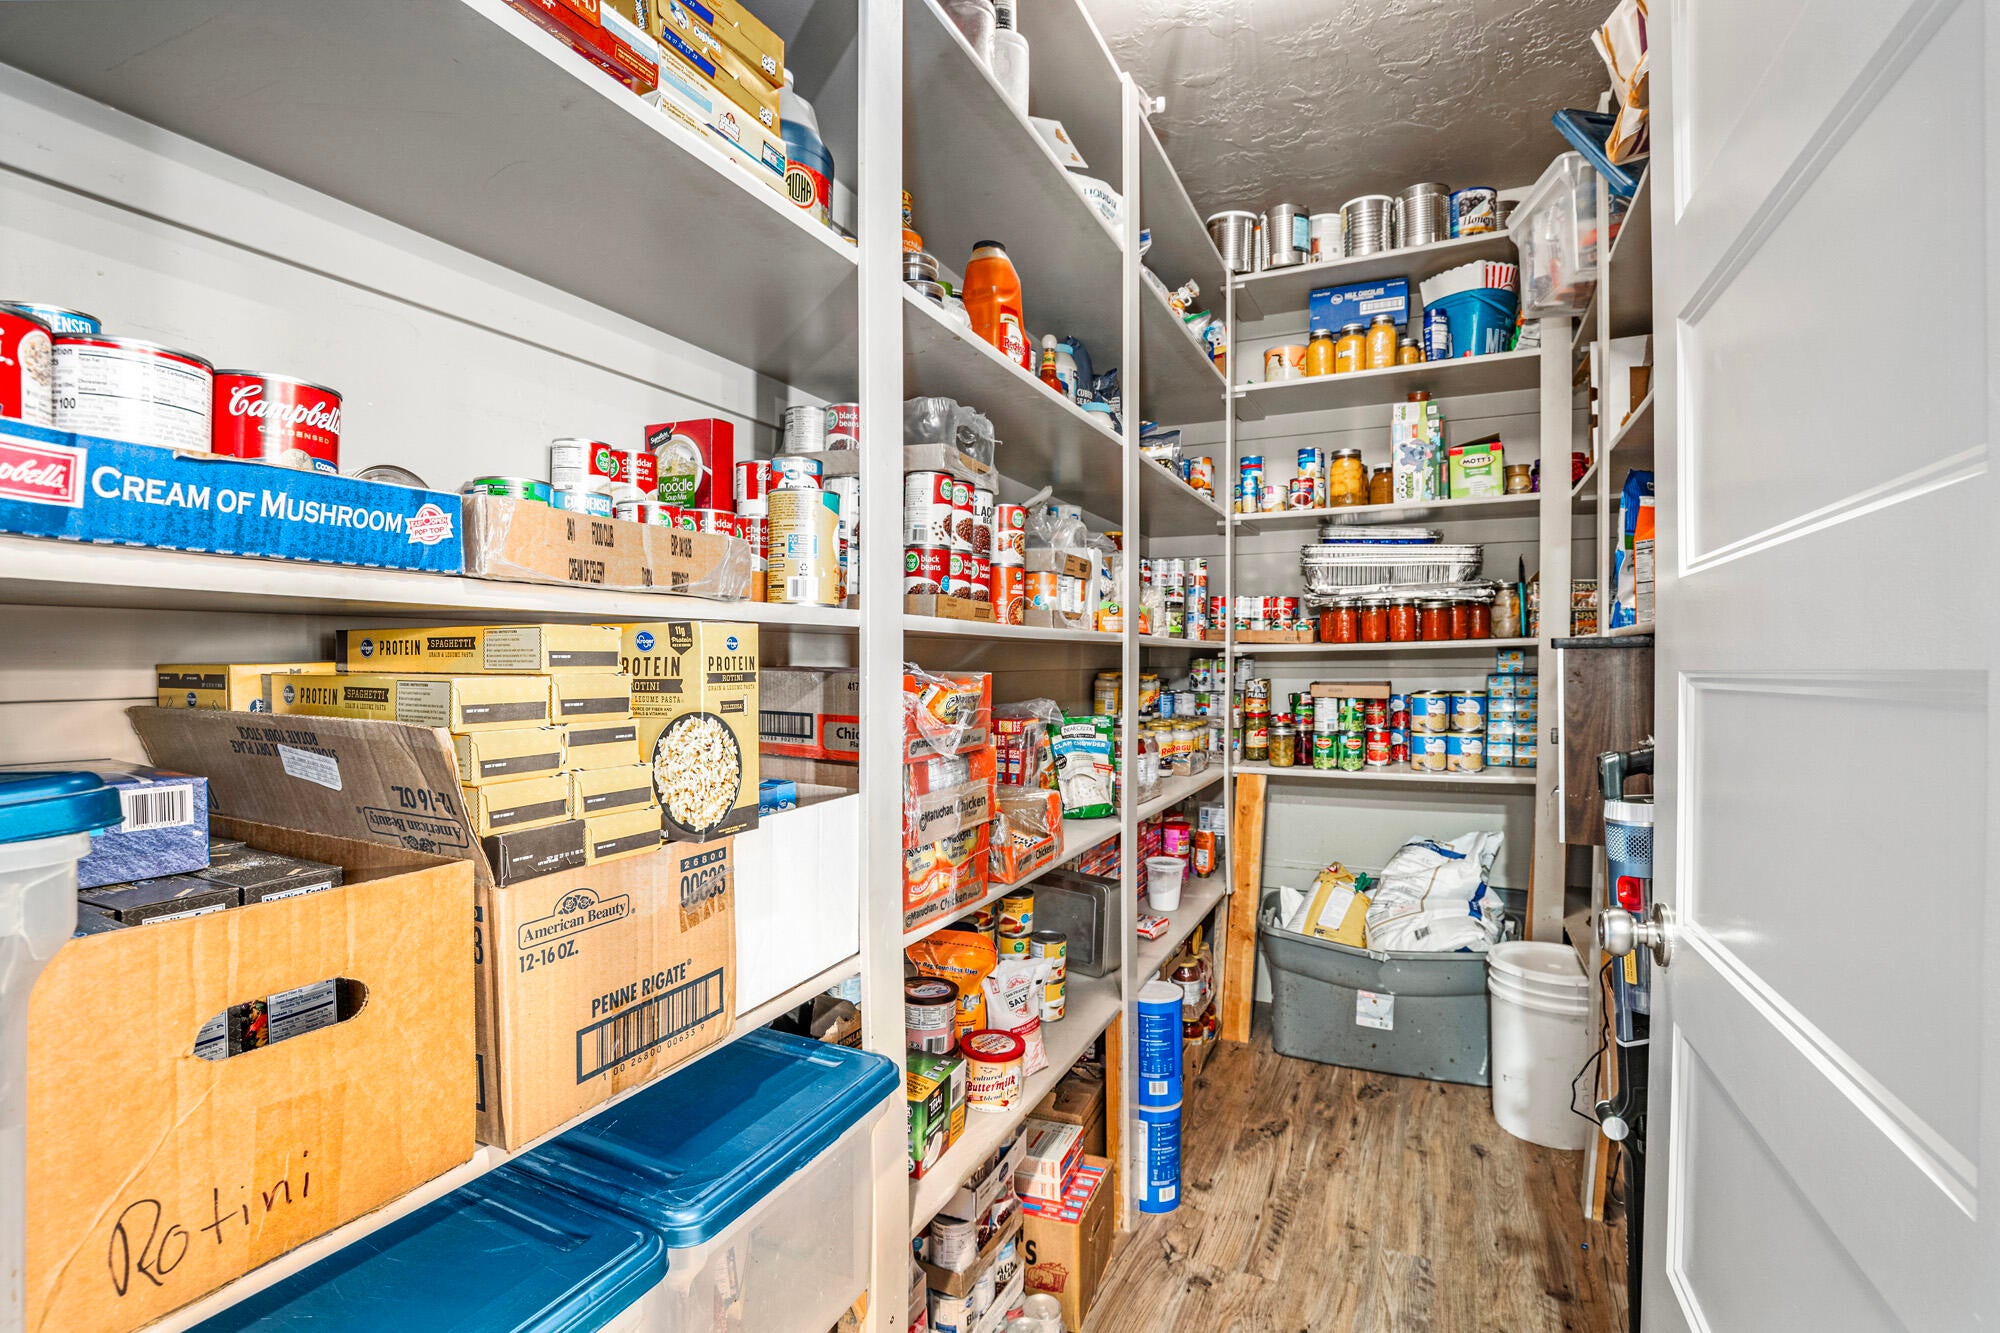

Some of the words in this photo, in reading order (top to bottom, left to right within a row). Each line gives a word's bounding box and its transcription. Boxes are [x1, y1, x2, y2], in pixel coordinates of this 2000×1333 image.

[786, 172, 812, 203] ALOHA
[60, 397, 76, 409] 100
[228, 384, 341, 436] Campbell's
[839, 411, 858, 420] black
[839, 420, 859, 428] beans
[257, 425, 330, 446] CNDENSED
[621, 456, 653, 468] chddar
[0, 458, 67, 489] pbell's
[621, 466, 649, 476] chese
[659, 479, 693, 492] noodle
[91, 466, 211, 511] CREAM
[216, 489, 256, 515] OF
[260, 489, 401, 533] MUSHROOM
[678, 493, 688, 501] Mix
[974, 505, 992, 517] LAC
[983, 516, 992, 525] BEA
[414, 527, 429, 537] POP
[430, 526, 445, 535] TOP
[592, 522, 603, 547] FOOD
[603, 524, 614, 548] CLUB
[746, 524, 768, 534] ched
[921, 555, 940, 563] black
[964, 560, 972, 568] bla
[569, 557, 583, 581] CREAM
[584, 559, 589, 582] OF
[590, 561, 605, 584] CELERY
[920, 563, 941, 571] beans
[675, 626, 686, 635] 11g
[379, 639, 421, 656] PROTEIN
[430, 638, 472, 649] SPAGHETTI
[622, 656, 680, 676] ROTEIN
[708, 656, 755, 671] PROTEIN
[722, 674, 743, 682] ROTINI
[632, 681, 660, 691] OTINI
[300, 687, 338, 705] PROTEIN
[347, 689, 385, 700] SPAGHETTI
[634, 695, 659, 703] LEGUME
[236, 725, 261, 741] STOCK
[262, 727, 287, 743] YOUR
[288, 729, 318, 745] ROTATE
[836, 727, 859, 740] Chic
[230, 739, 254, 754] PLACE
[255, 742, 272, 756] DRY
[1054, 741, 1072, 750] CLAM
[1074, 740, 1106, 749] CHOWDER
[391, 785, 417, 809] OZ.
[417, 787, 457, 815] 12-16
[922, 804, 954, 825] Maruchan
[957, 795, 986, 812] Chicken
[369, 811, 406, 832] Beauty
[407, 820, 461, 840] American
[684, 851, 724, 869] 26800
[1036, 845, 1051, 860] Chicken
[523, 914, 584, 943] American
[587, 901, 627, 923] Beauty
[519, 947, 556, 973] 12-16
[557, 940, 579, 961] OZ.
[592, 982, 638, 1018] PENNE
[642, 962, 687, 997] RIGATE
[1008, 994, 1028, 1008] SALT
[602, 1072, 607, 1080] 1
[613, 1063, 626, 1075] 00
[631, 1045, 662, 1067] 26800
[667, 1029, 696, 1048] 00633
[700, 1023, 705, 1032] 9
[967, 1075, 1016, 1093] Buttermilk
[973, 1073, 1003, 1081] cultured
[983, 1094, 1003, 1102] blend
[109, 1150, 310, 1296] Rotini
